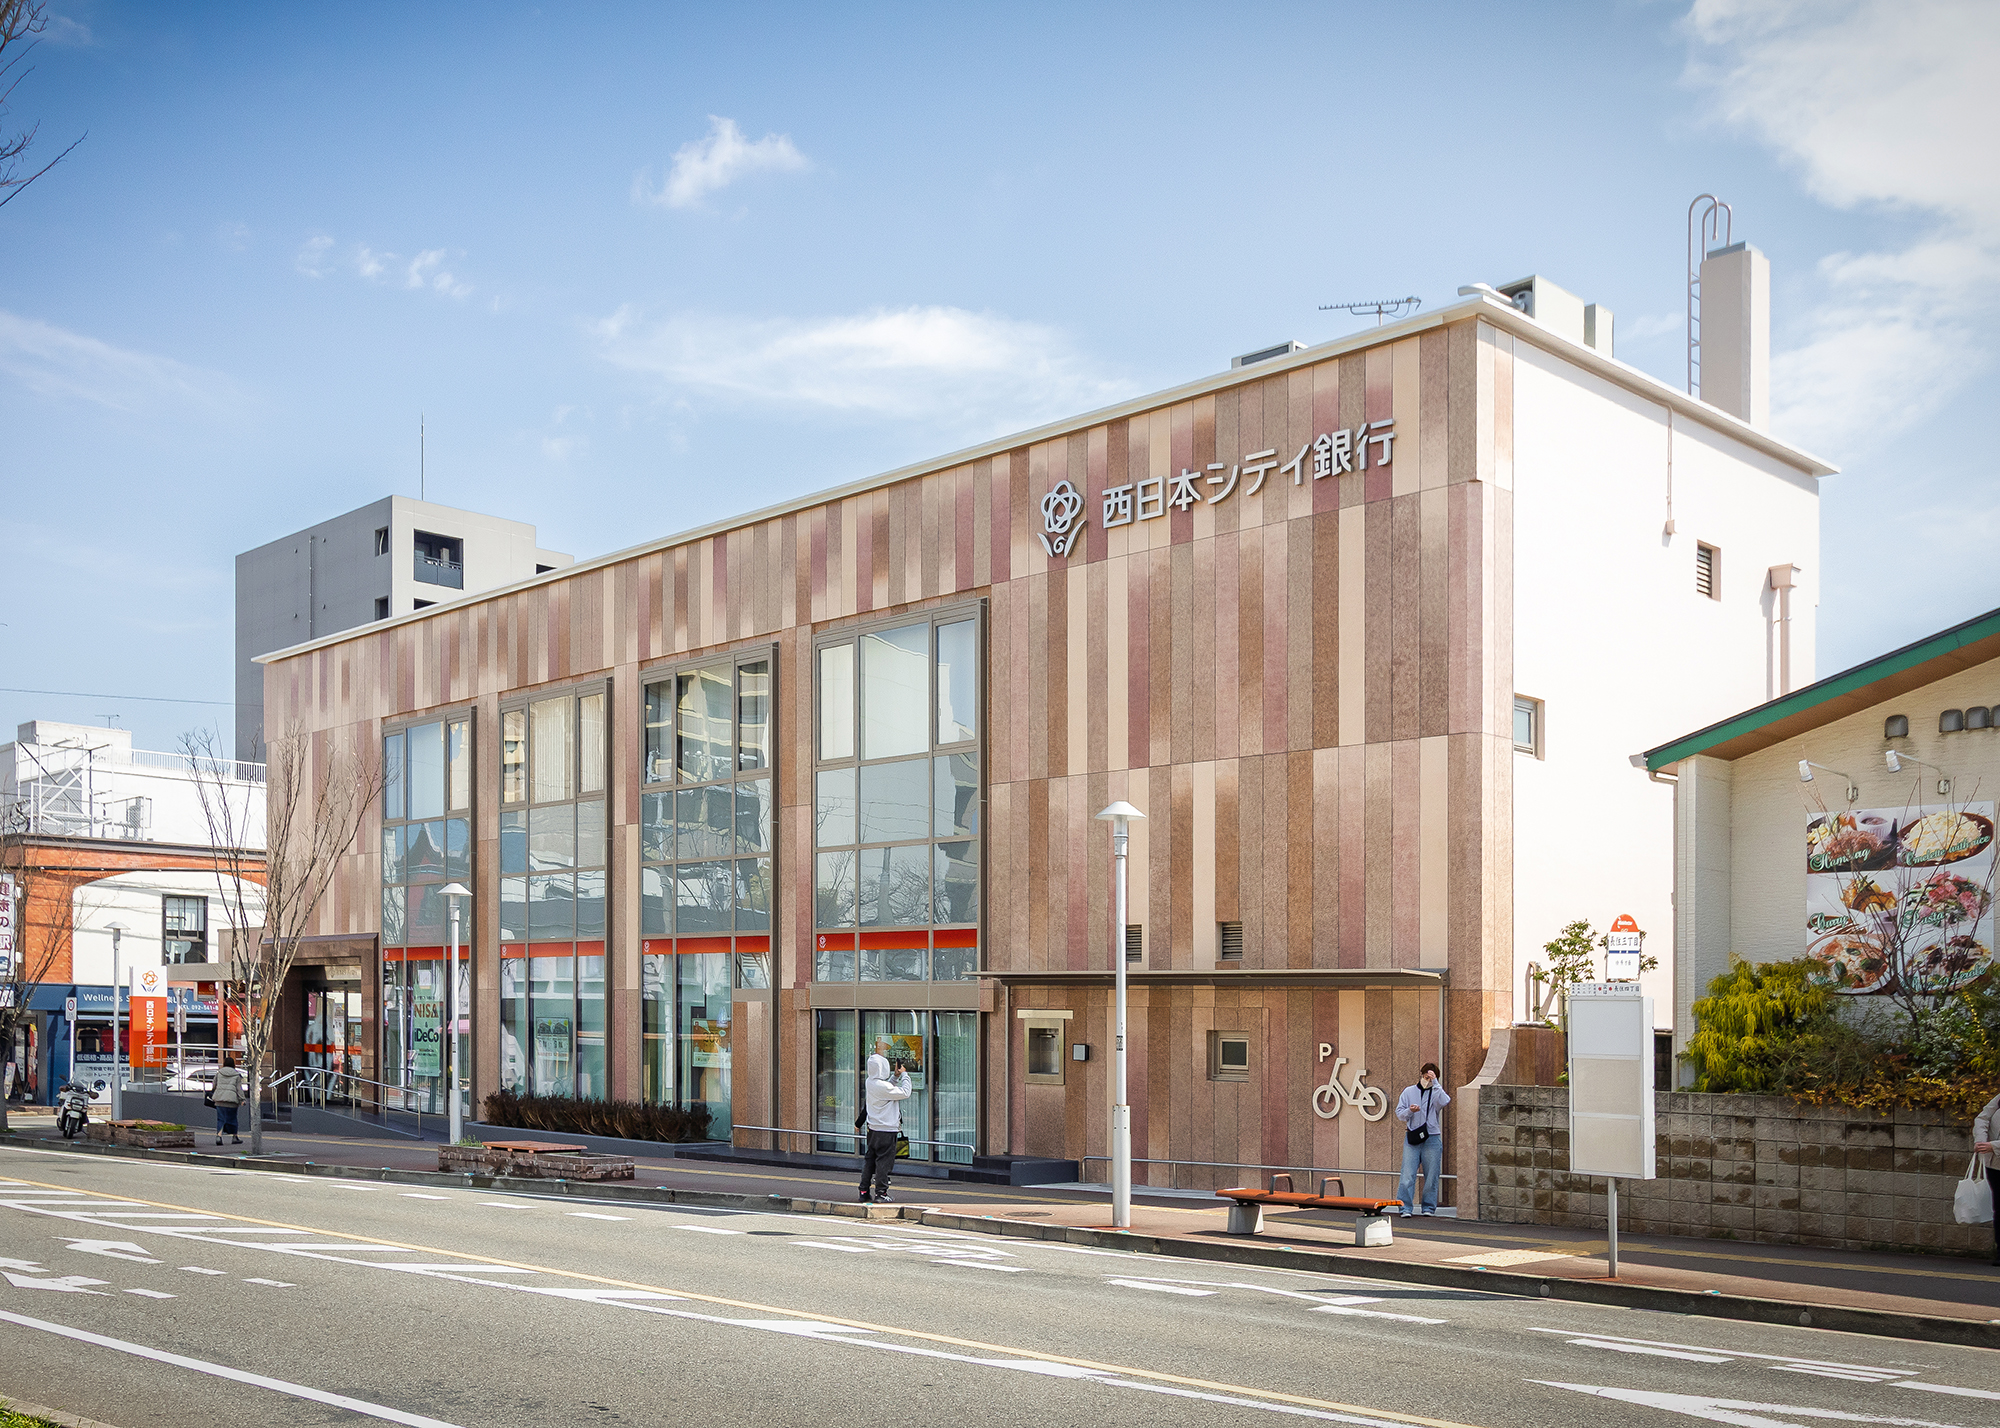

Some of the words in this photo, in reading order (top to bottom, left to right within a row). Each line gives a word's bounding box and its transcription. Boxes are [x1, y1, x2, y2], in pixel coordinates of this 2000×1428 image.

[1102, 418, 1396, 529] 西日本シティ銀行
[83, 993, 123, 1002] Wellnes
[414, 1003, 439, 1018] NISA
[414, 1028, 439, 1043] iDeCo
[1319, 1043, 1333, 1063] P
